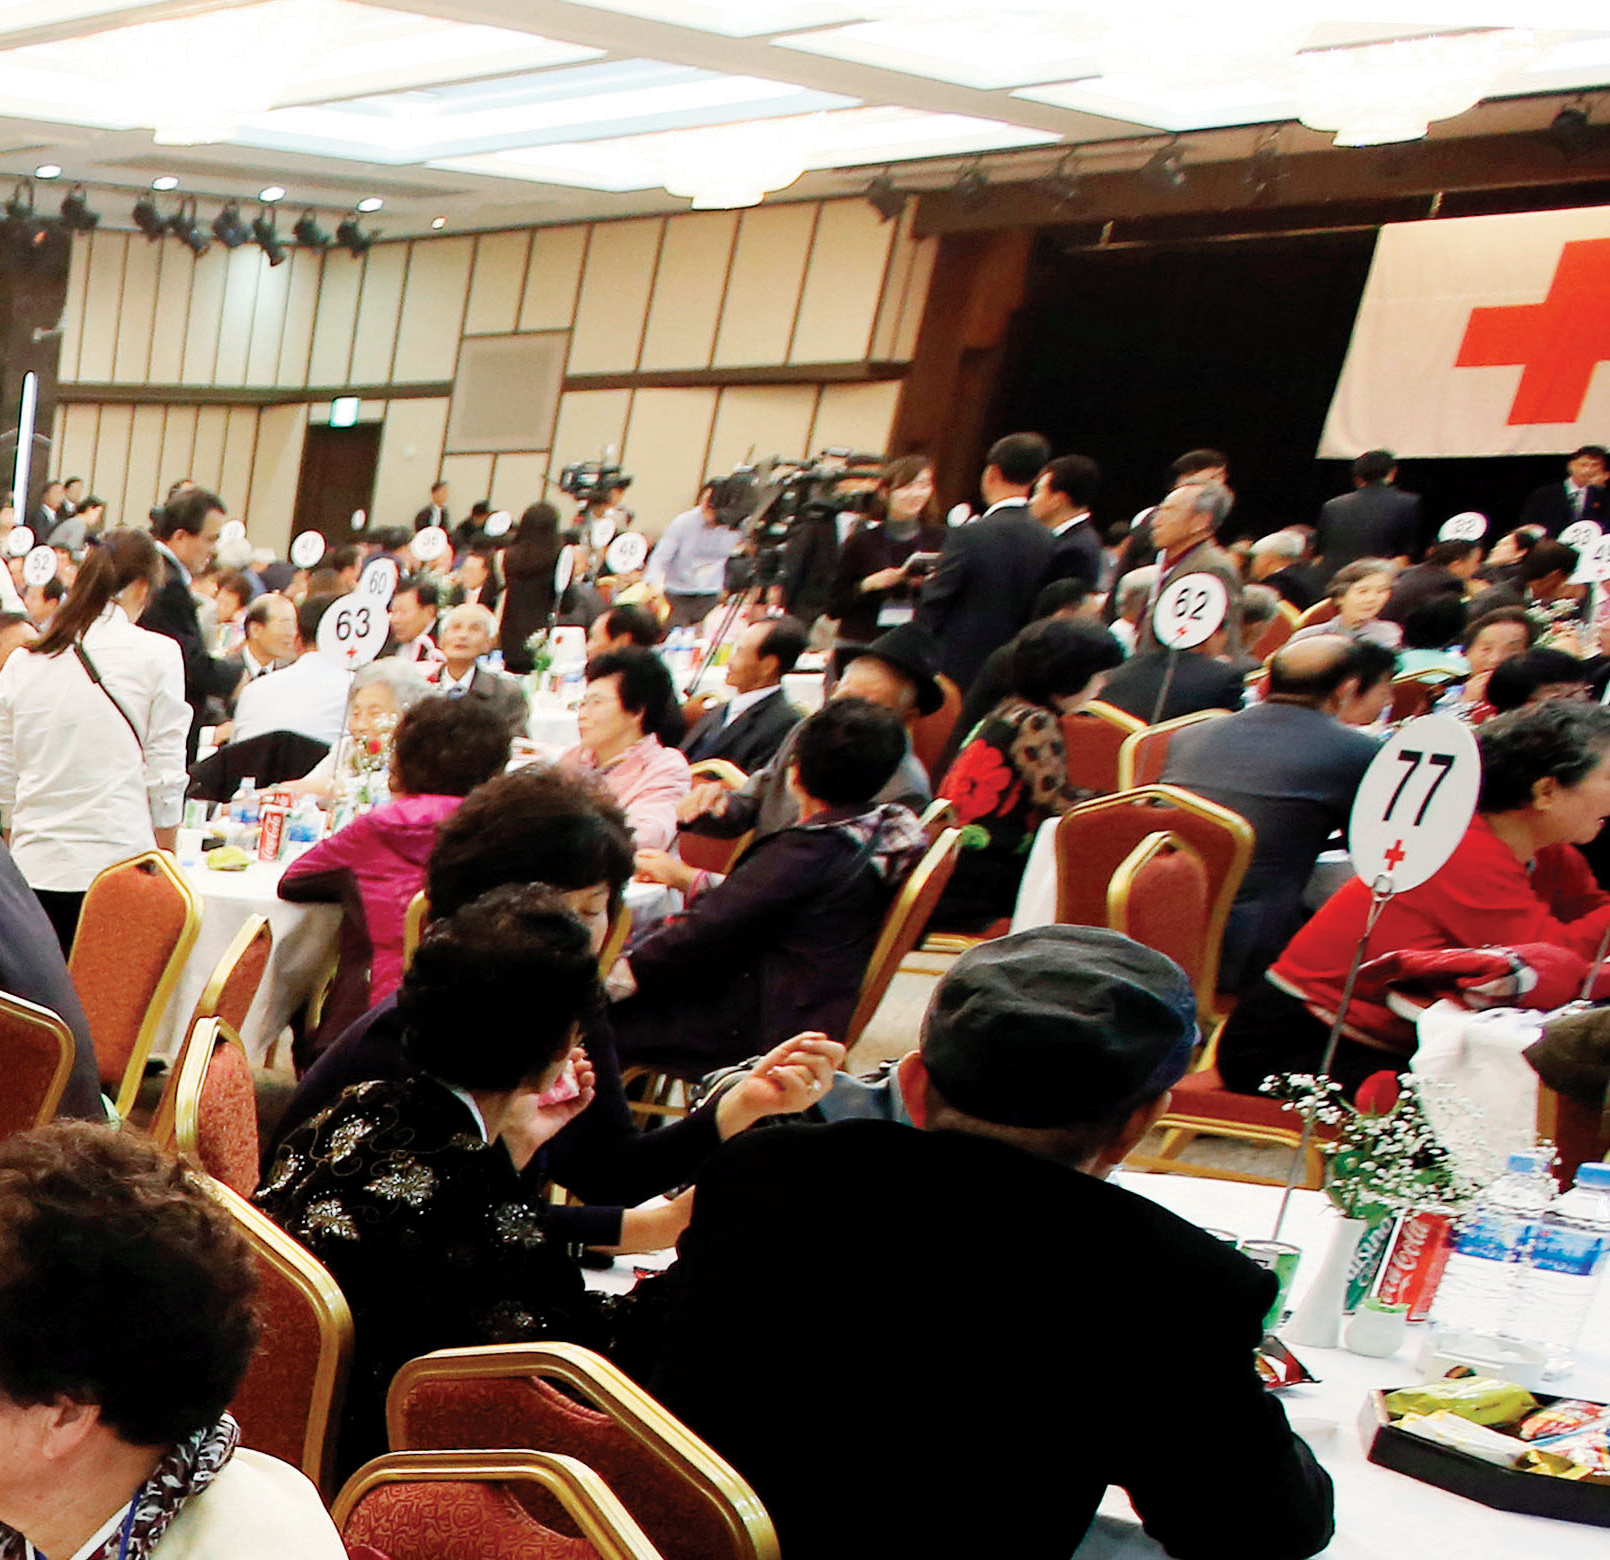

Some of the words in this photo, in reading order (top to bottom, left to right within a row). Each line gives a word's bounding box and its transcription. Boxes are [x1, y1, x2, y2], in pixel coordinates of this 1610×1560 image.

[33, 552, 49, 571] 52
[369, 570, 388, 595] 60
[1174, 588, 1209, 620] 62
[335, 607, 371, 641] 63
[1382, 749, 1455, 826] 77
